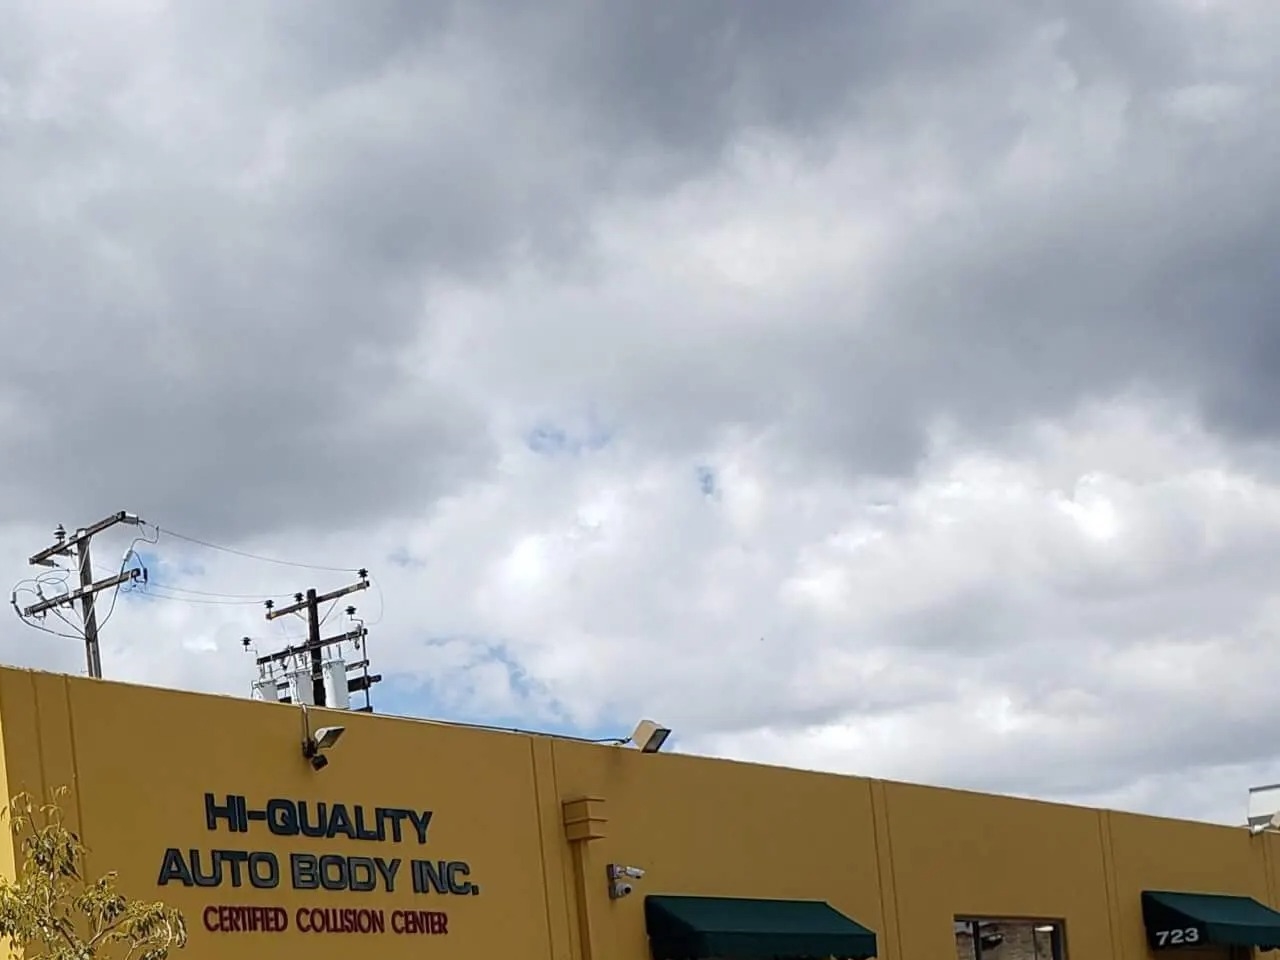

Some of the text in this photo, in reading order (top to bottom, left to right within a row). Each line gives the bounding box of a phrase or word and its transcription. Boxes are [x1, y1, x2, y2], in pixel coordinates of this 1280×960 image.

[205, 793, 433, 844] HI-QUALITY
[158, 848, 480, 895] AUTO BODY INC.
[203, 906, 448, 934] CERTIFIED COLLISION CENTER
[1156, 927, 1199, 946] 723
